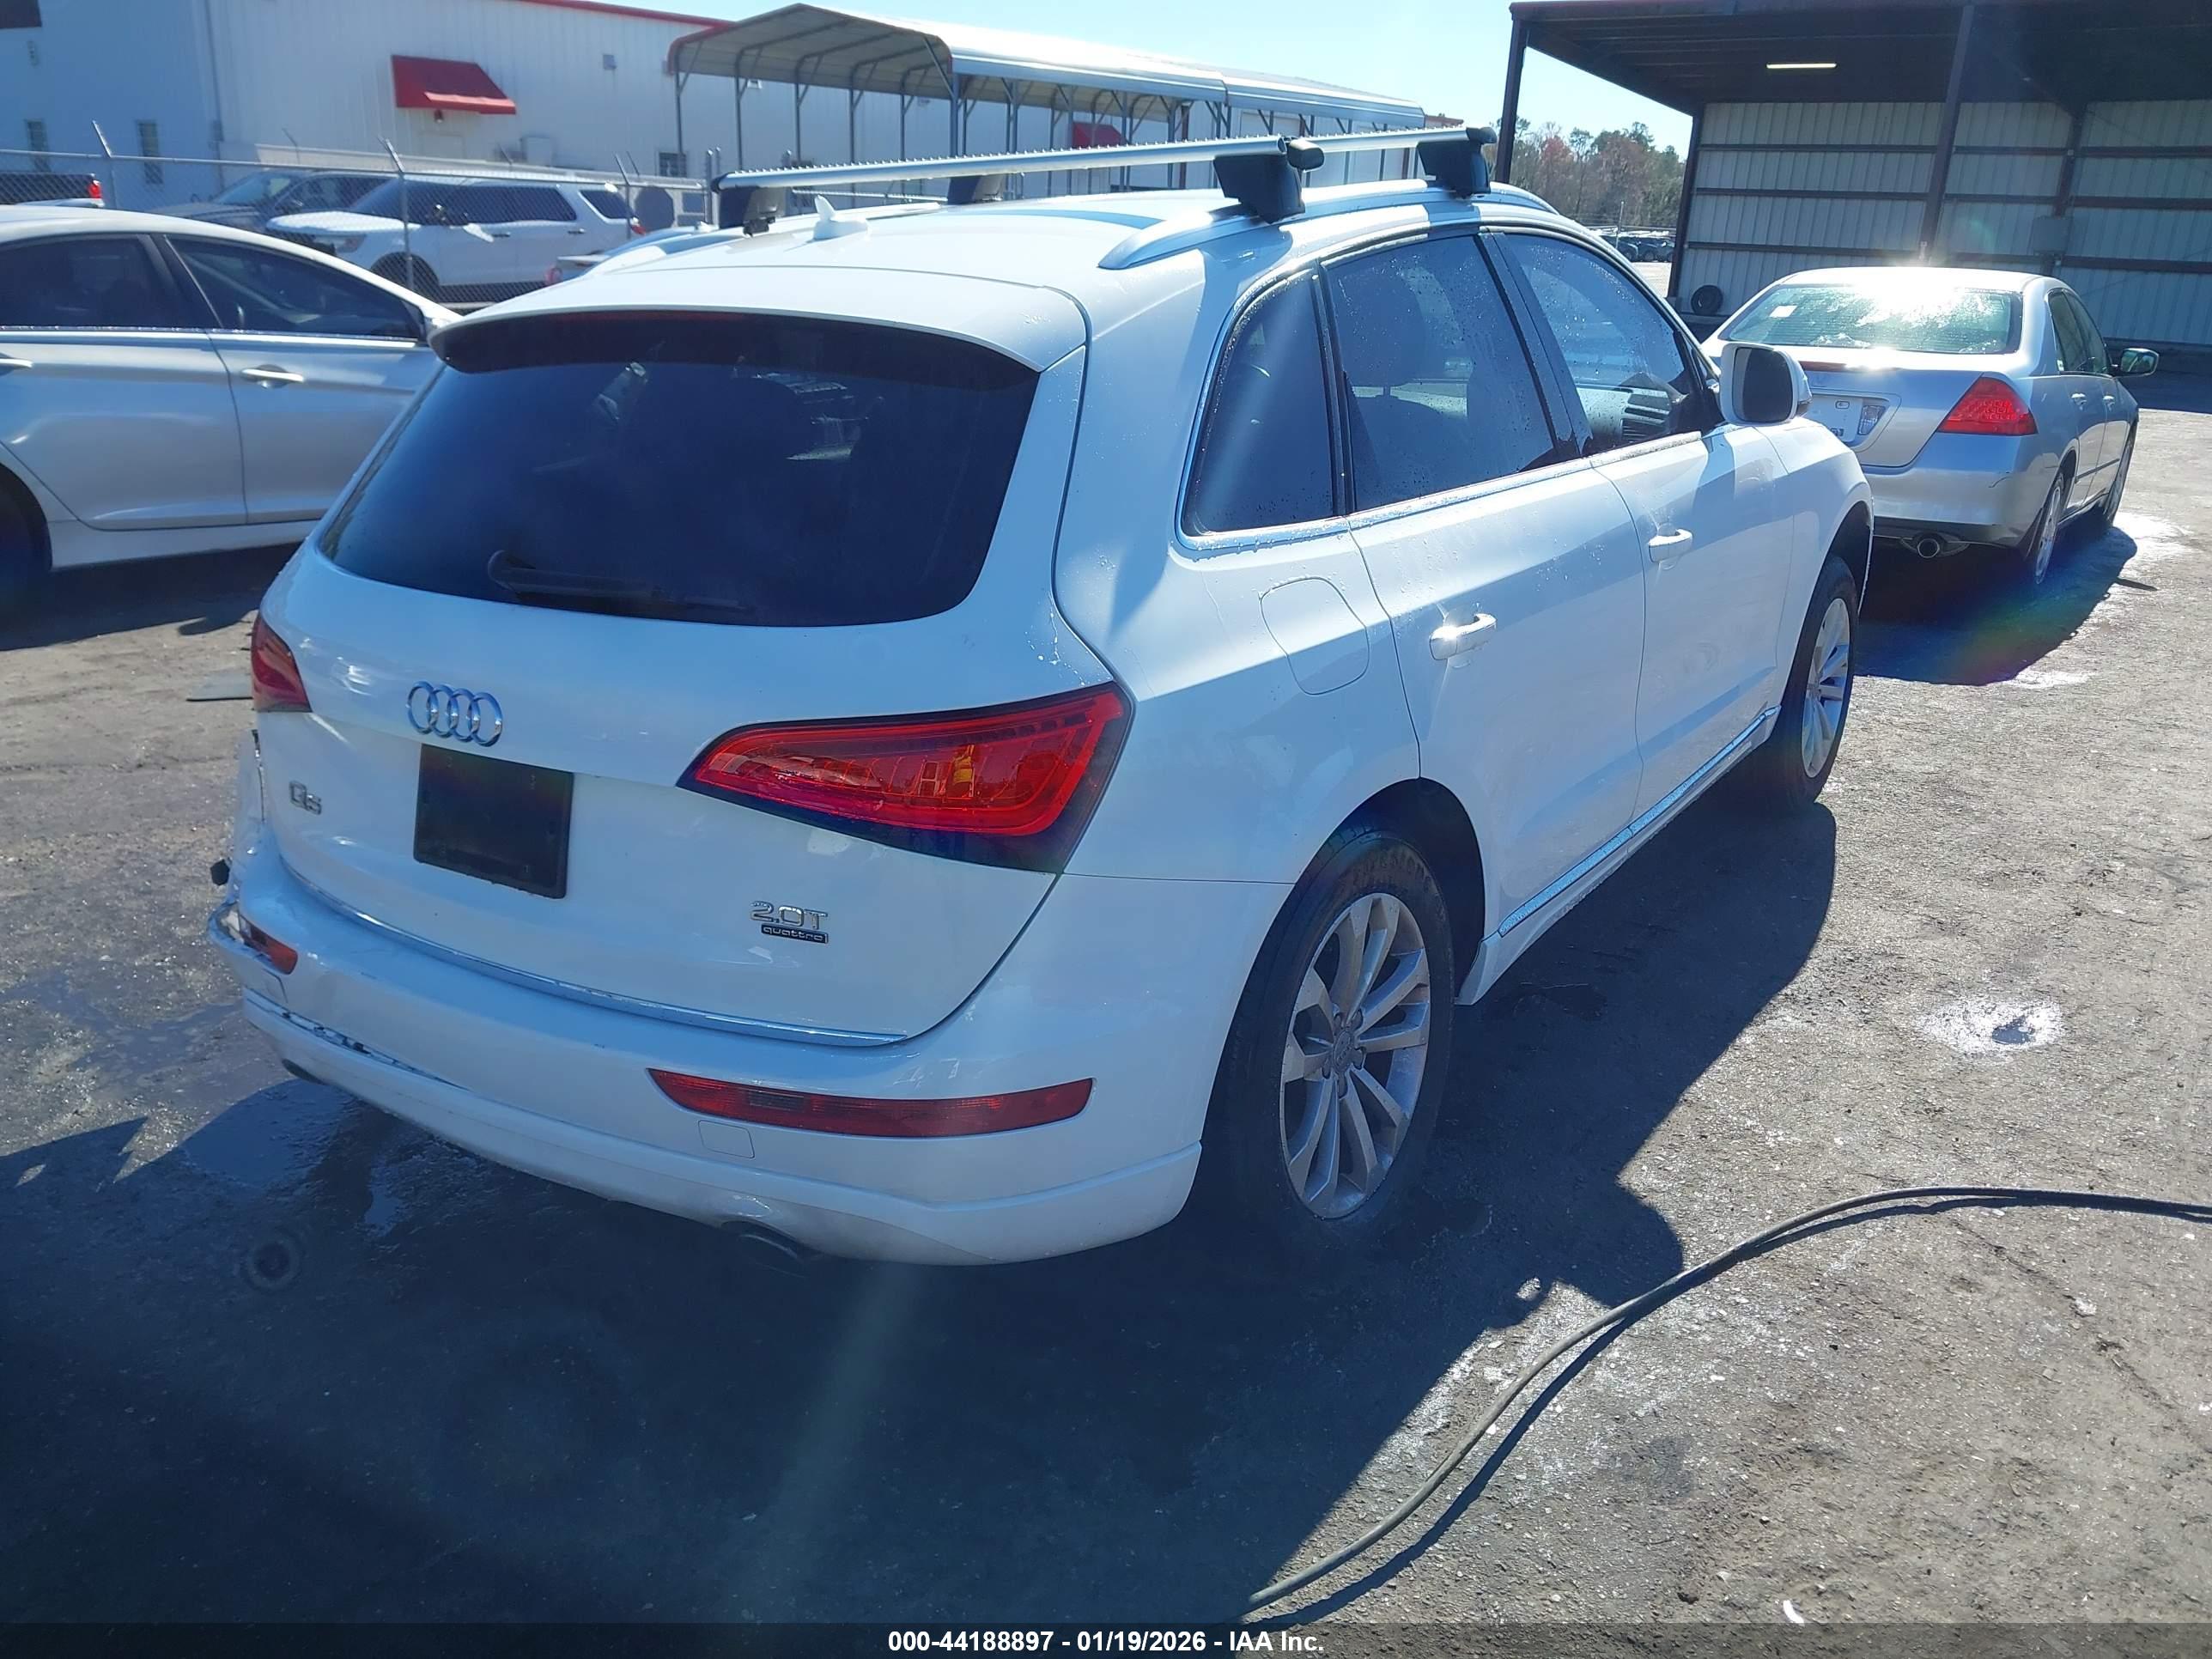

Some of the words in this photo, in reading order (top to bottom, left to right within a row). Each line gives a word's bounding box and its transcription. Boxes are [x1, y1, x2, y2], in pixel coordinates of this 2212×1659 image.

[289, 781, 322, 816] Q5
[750, 900, 829, 930] 2.0T
[762, 925, 824, 943] quattro
